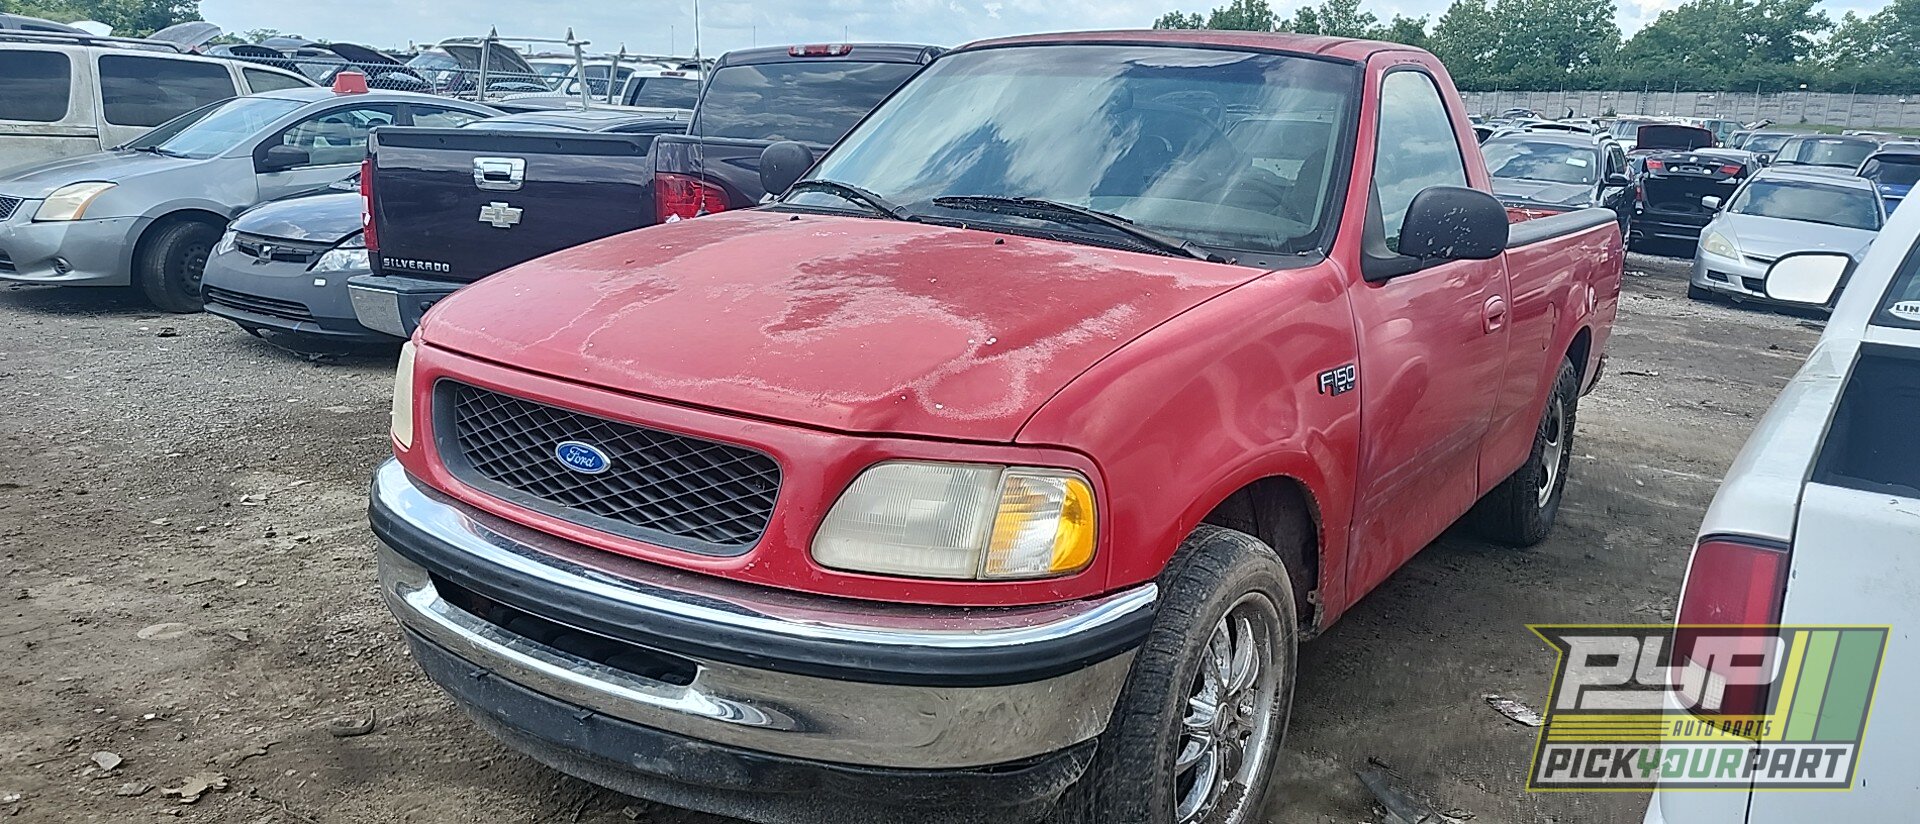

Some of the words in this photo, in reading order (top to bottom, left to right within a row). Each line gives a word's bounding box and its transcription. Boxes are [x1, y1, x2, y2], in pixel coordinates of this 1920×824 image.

[383, 257, 450, 272] SILVERADO
[1320, 365, 1356, 393] F150
[1339, 383, 1353, 393] XL
[566, 446, 596, 468] Ford
